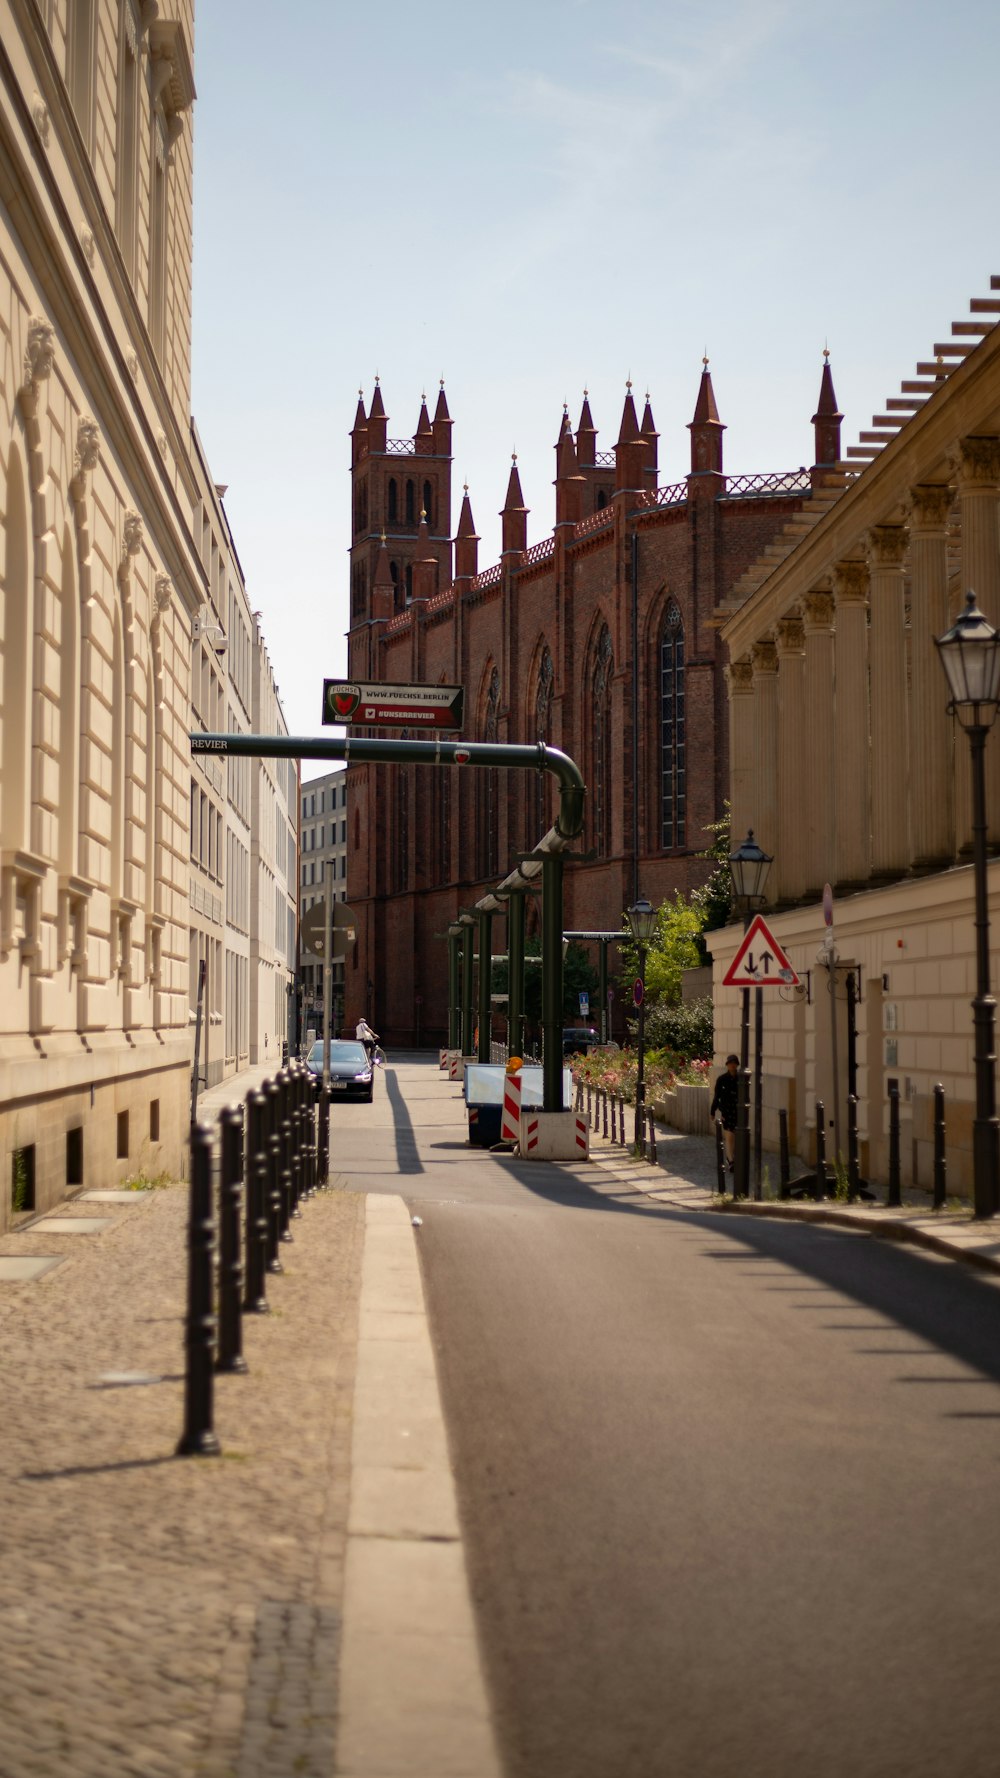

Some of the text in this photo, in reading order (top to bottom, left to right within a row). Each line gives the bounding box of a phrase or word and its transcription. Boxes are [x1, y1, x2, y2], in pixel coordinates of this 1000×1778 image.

[366, 691, 450, 700] WWW.FUECHSE.BERLIN
[378, 711, 435, 719] #UNSERREVIER
[191, 739, 227, 749] REVIER
